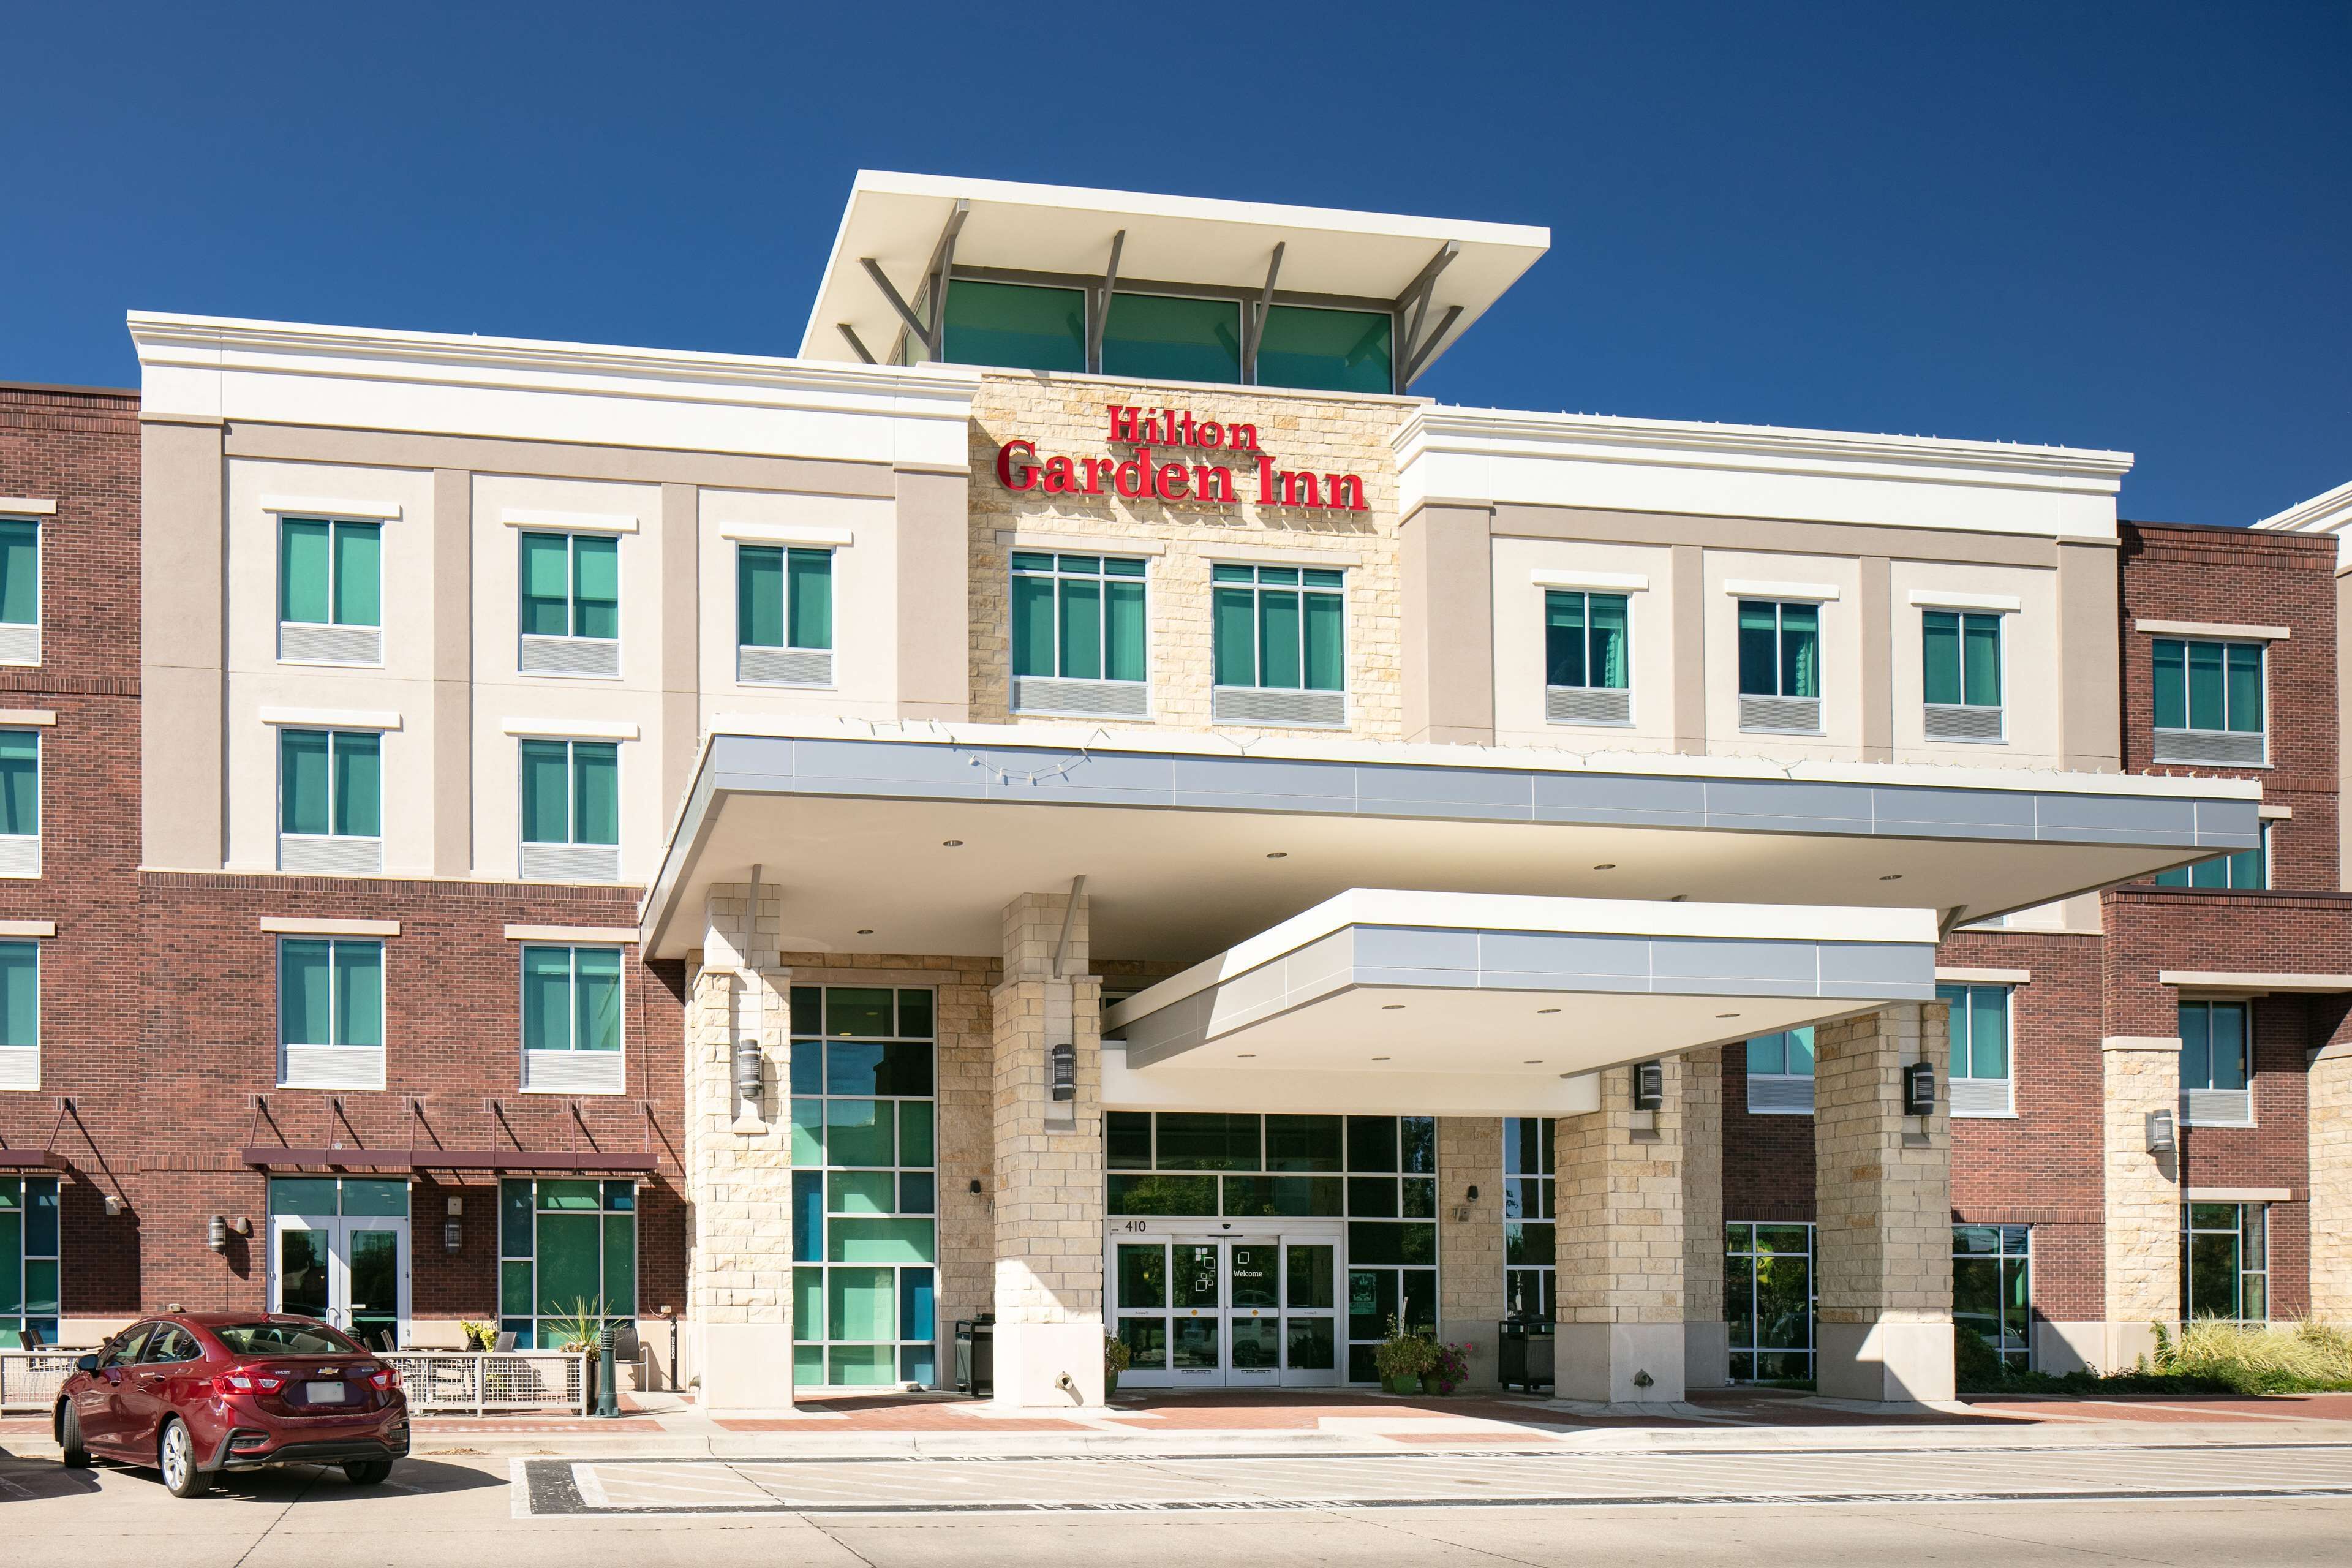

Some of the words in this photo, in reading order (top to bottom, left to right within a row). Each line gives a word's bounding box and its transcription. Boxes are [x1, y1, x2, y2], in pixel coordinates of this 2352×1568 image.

[1107, 405, 1261, 451] Hilton
[996, 439, 1238, 505] Garden
[1254, 455, 1369, 511] Inn
[1125, 1221, 1146, 1232] 410
